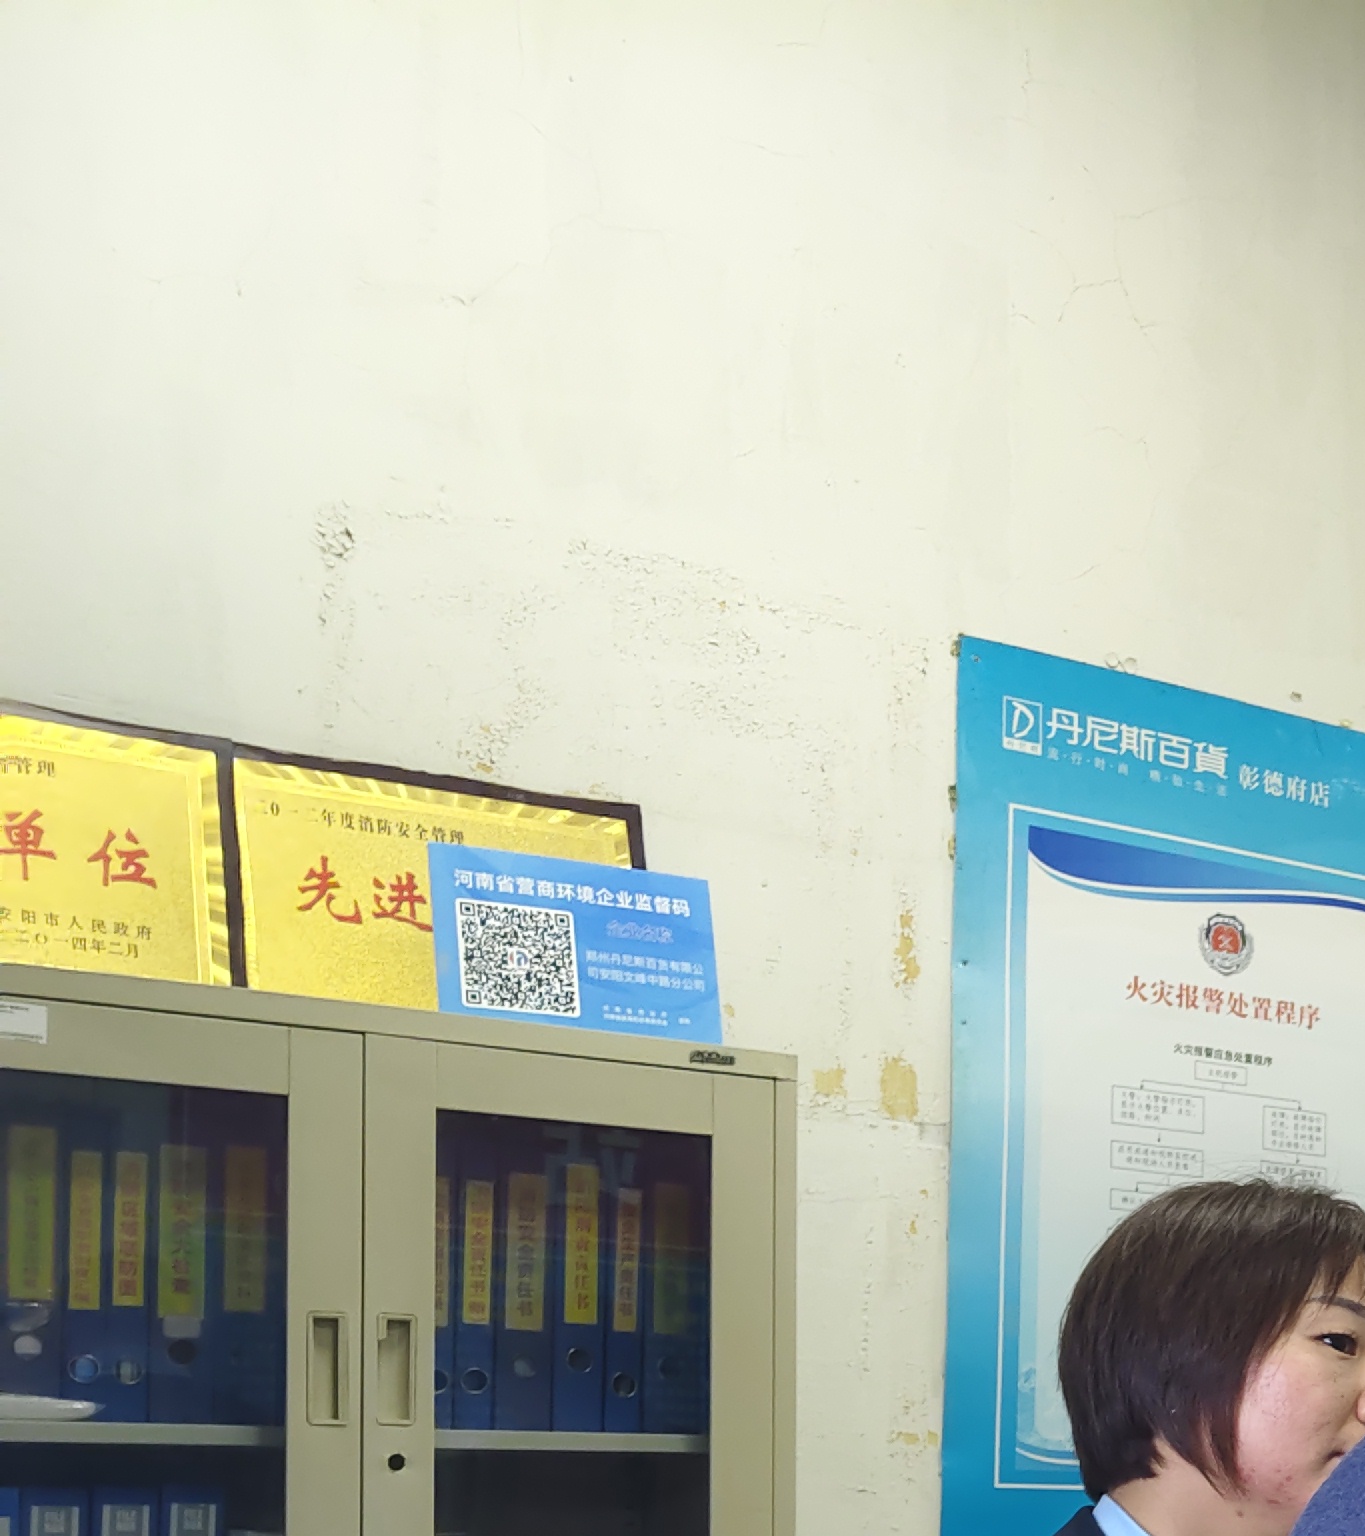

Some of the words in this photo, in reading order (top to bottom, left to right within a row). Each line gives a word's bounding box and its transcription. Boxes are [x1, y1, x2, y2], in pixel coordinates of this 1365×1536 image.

[1046, 708, 1229, 779] 丹尼斯百貨
[1239, 764, 1330, 808] 彰德府店
[296, 855, 433, 932] 先进
[454, 868, 691, 918] 河南省营商环境企业监督码
[1125, 976, 1321, 1030] 火灾报警处置程序
